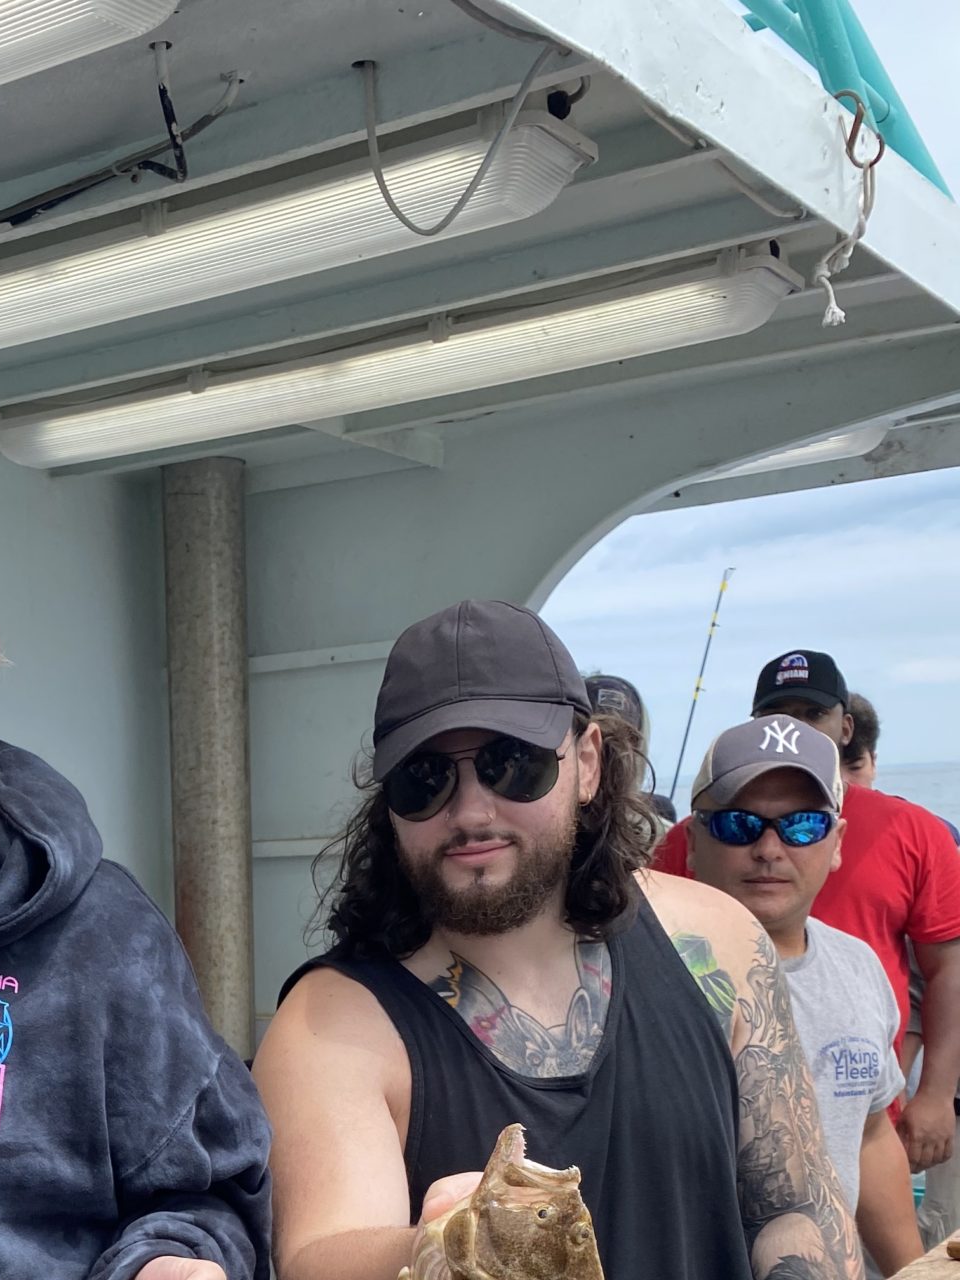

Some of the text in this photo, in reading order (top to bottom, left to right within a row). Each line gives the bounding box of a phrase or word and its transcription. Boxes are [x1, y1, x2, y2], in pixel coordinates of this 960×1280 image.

[759, 720, 800, 755] NY
[831, 1048, 879, 1067] Viking
[835, 1064, 874, 1081] Fleet
